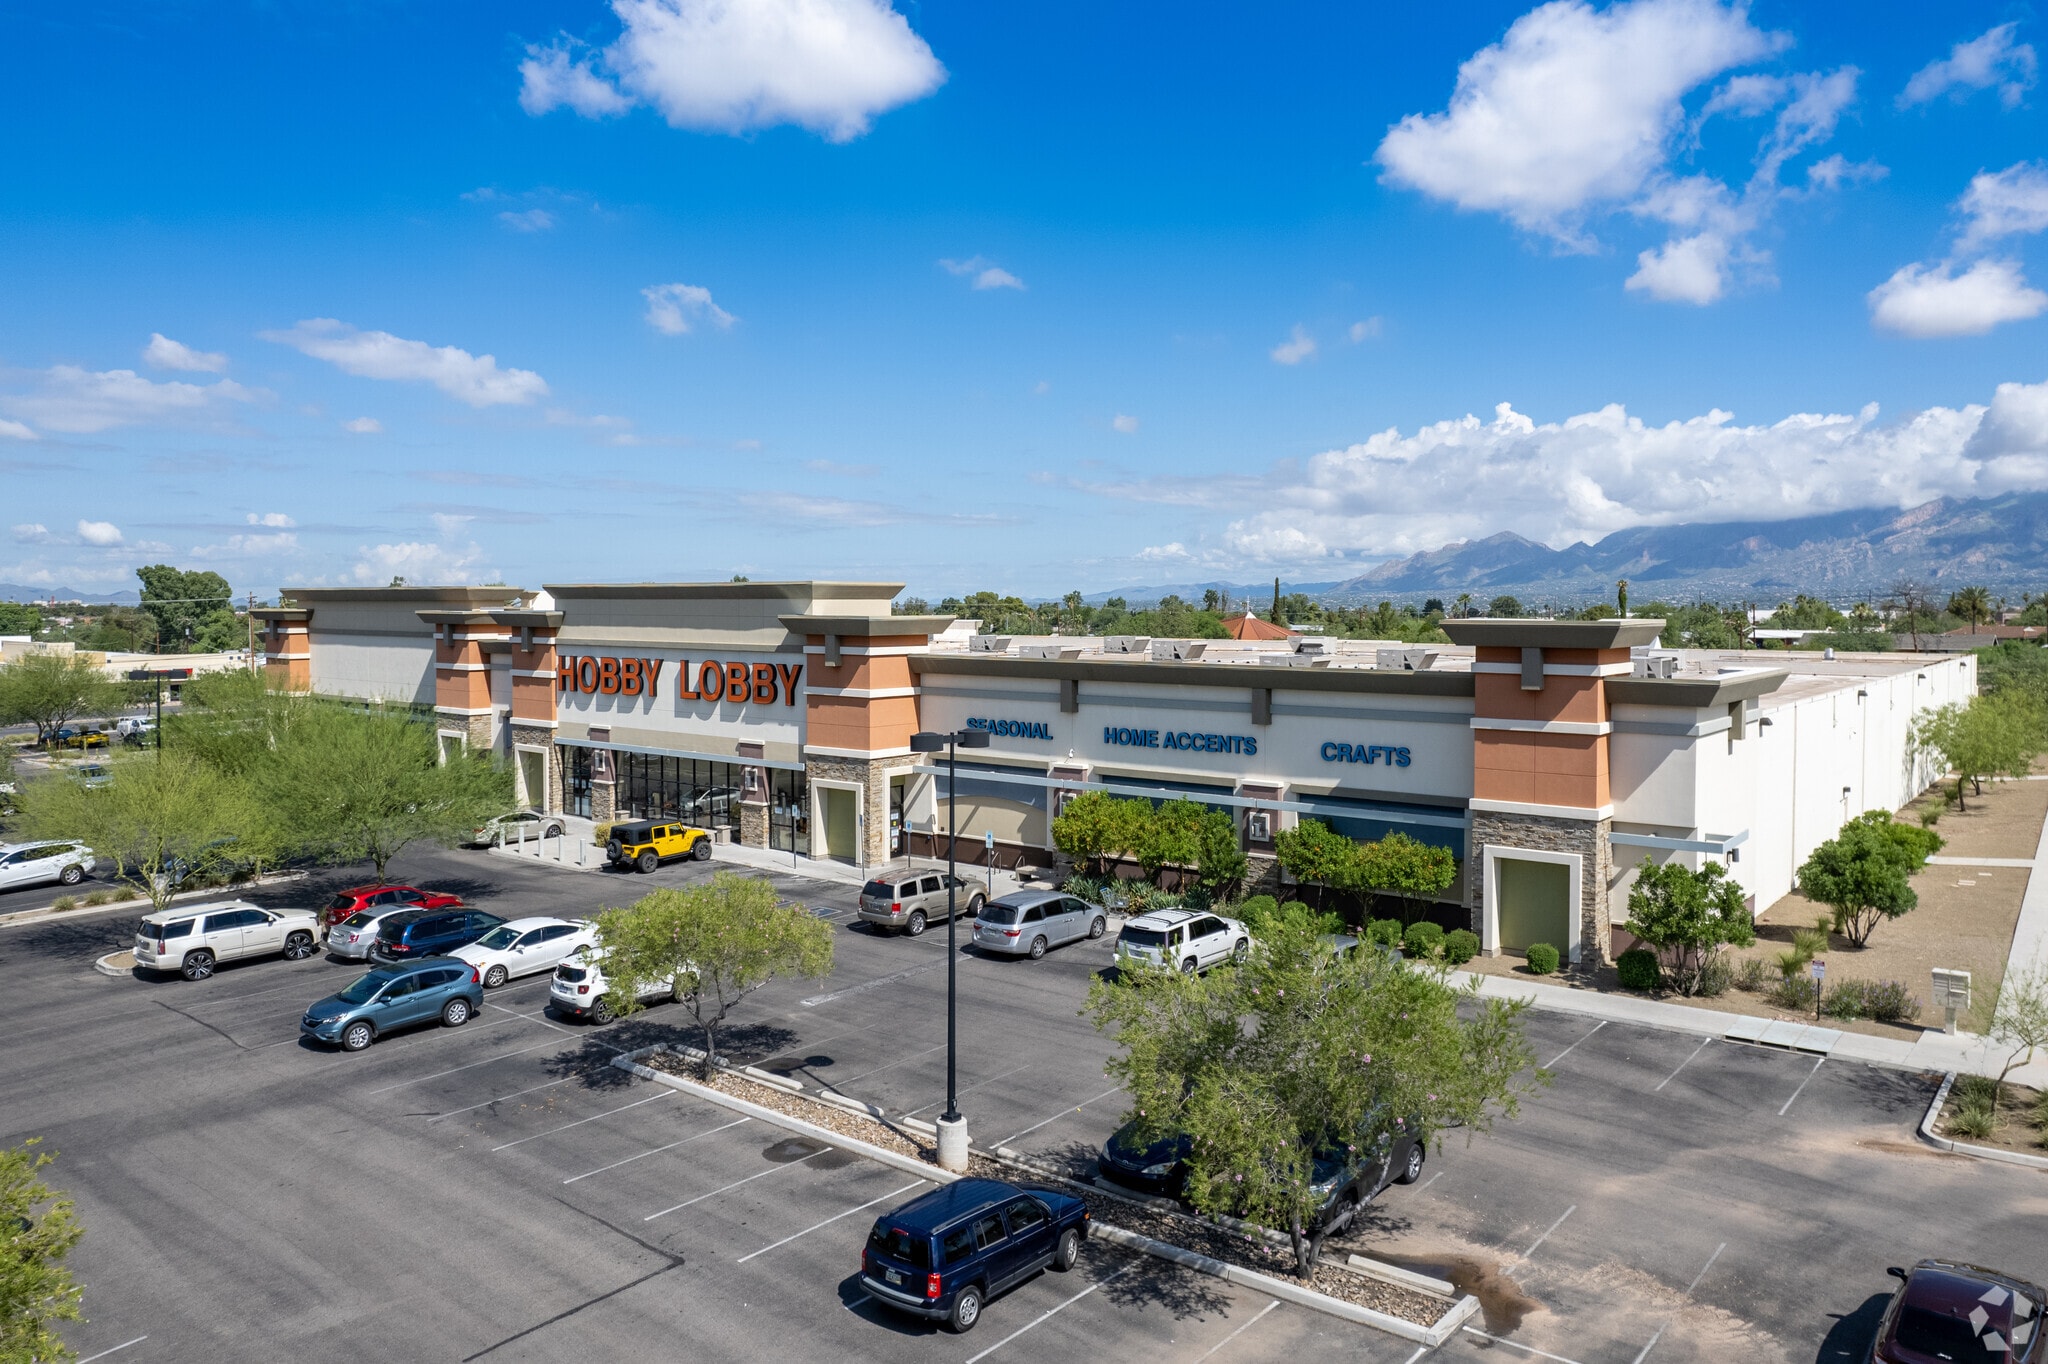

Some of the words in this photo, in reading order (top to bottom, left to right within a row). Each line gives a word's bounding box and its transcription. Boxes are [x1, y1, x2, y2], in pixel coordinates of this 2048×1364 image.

[558, 655, 664, 697] HOBBY
[680, 659, 803, 706] LOBBY
[967, 717, 1053, 740] SEASONAL
[1104, 727, 1158, 749] HOME
[1163, 732, 1257, 755] ACCENTS
[1321, 742, 1411, 767] CRAFTS
